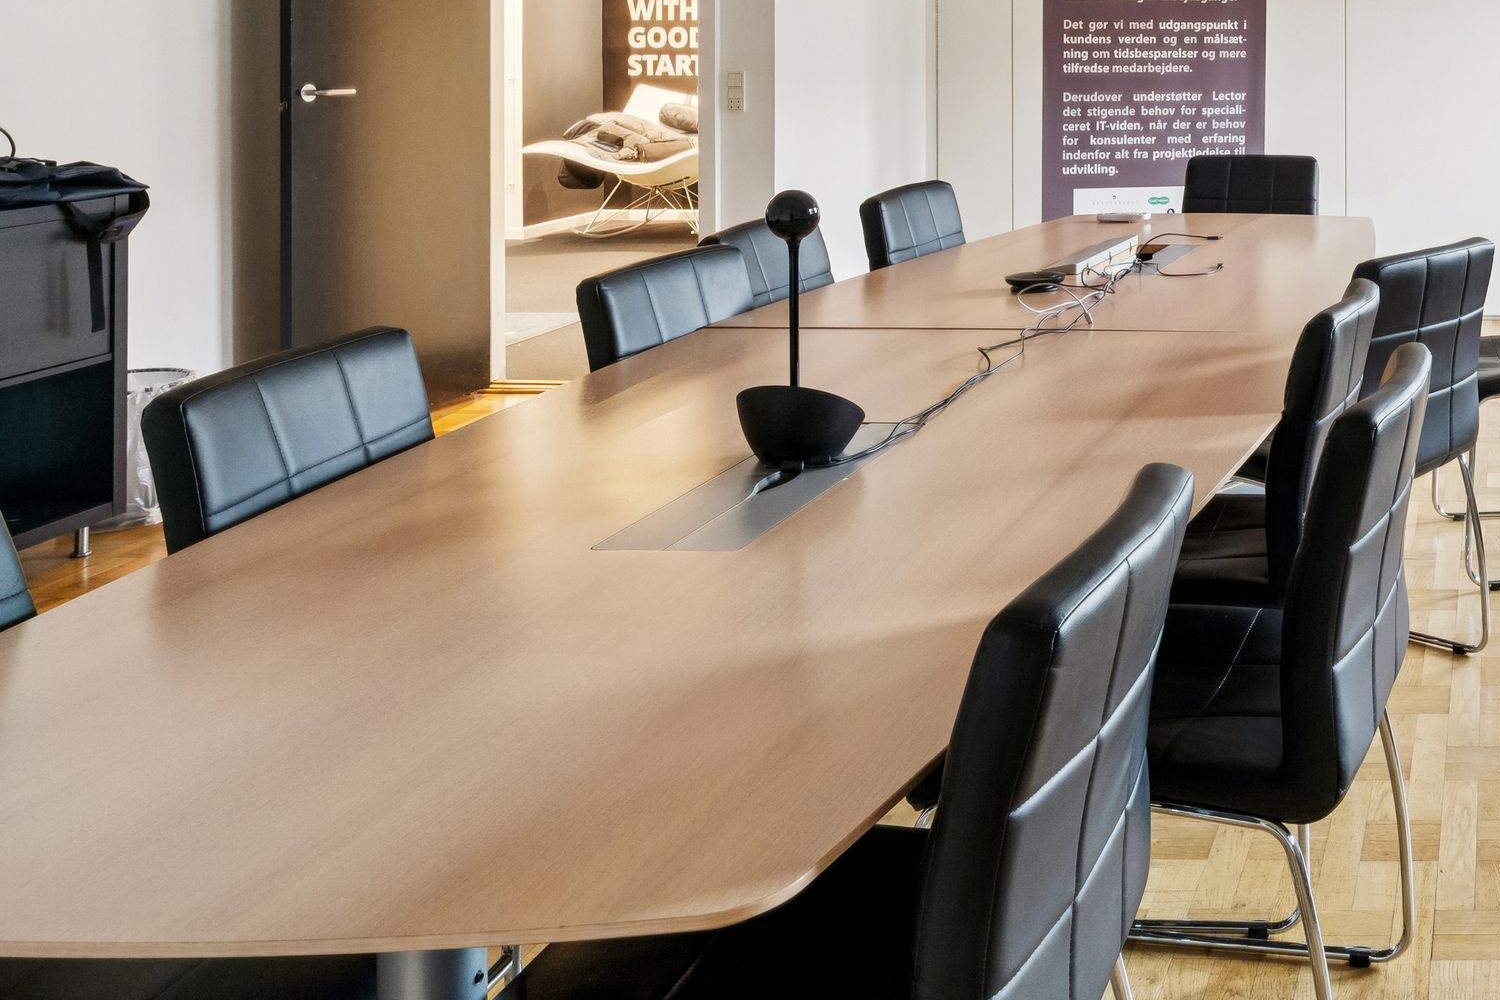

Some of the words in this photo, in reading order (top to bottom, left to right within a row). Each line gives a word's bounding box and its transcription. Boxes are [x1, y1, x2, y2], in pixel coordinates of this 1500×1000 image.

[627, 0, 698, 21] WITH
[1064, 20, 1083, 29] Det
[1089, 22, 1108, 32] gør
[1114, 20, 1123, 29] vi
[1129, 19, 1153, 29] med
[1159, 20, 1238, 32] udgangspunkt
[1064, 34, 1111, 44] kundens
[1118, 34, 1156, 43] verden
[1163, 37, 1177, 46] og
[1204, 34, 1246, 44] målsæt-
[1064, 49, 1088, 61] ning
[1114, 48, 1198, 60] tidsbesparelser
[1202, 51, 1215, 60] og
[1063, 63, 1109, 73] tilfredse
[1112, 62, 1192, 75] medarbejdere.
[1063, 92, 1122, 102] Derudover
[1133, 91, 1202, 101] understøtter
[1213, 91, 1246, 100] Lector
[1063, 106, 1081, 116] det
[1087, 106, 1135, 119] stigende
[1141, 106, 1175, 115] behov
[1181, 105, 1196, 115] for
[1202, 105, 1246, 117] speciali-
[1063, 122, 1090, 131] ceret
[1096, 120, 1143, 131] IT-viden,
[1149, 120, 1167, 129] når
[1173, 120, 1191, 129] der
[1212, 119, 1245, 129] behov
[1063, 135, 1078, 145] for
[1090, 134, 1156, 145] konsulenter
[1168, 134, 1191, 143] med
[1202, 133, 1245, 145] erfaring
[1063, 149, 1111, 160] indenfor
[1115, 149, 1129, 159] alt
[1133, 149, 1148, 158] fra
[1063, 164, 1118, 176] udvikling.
